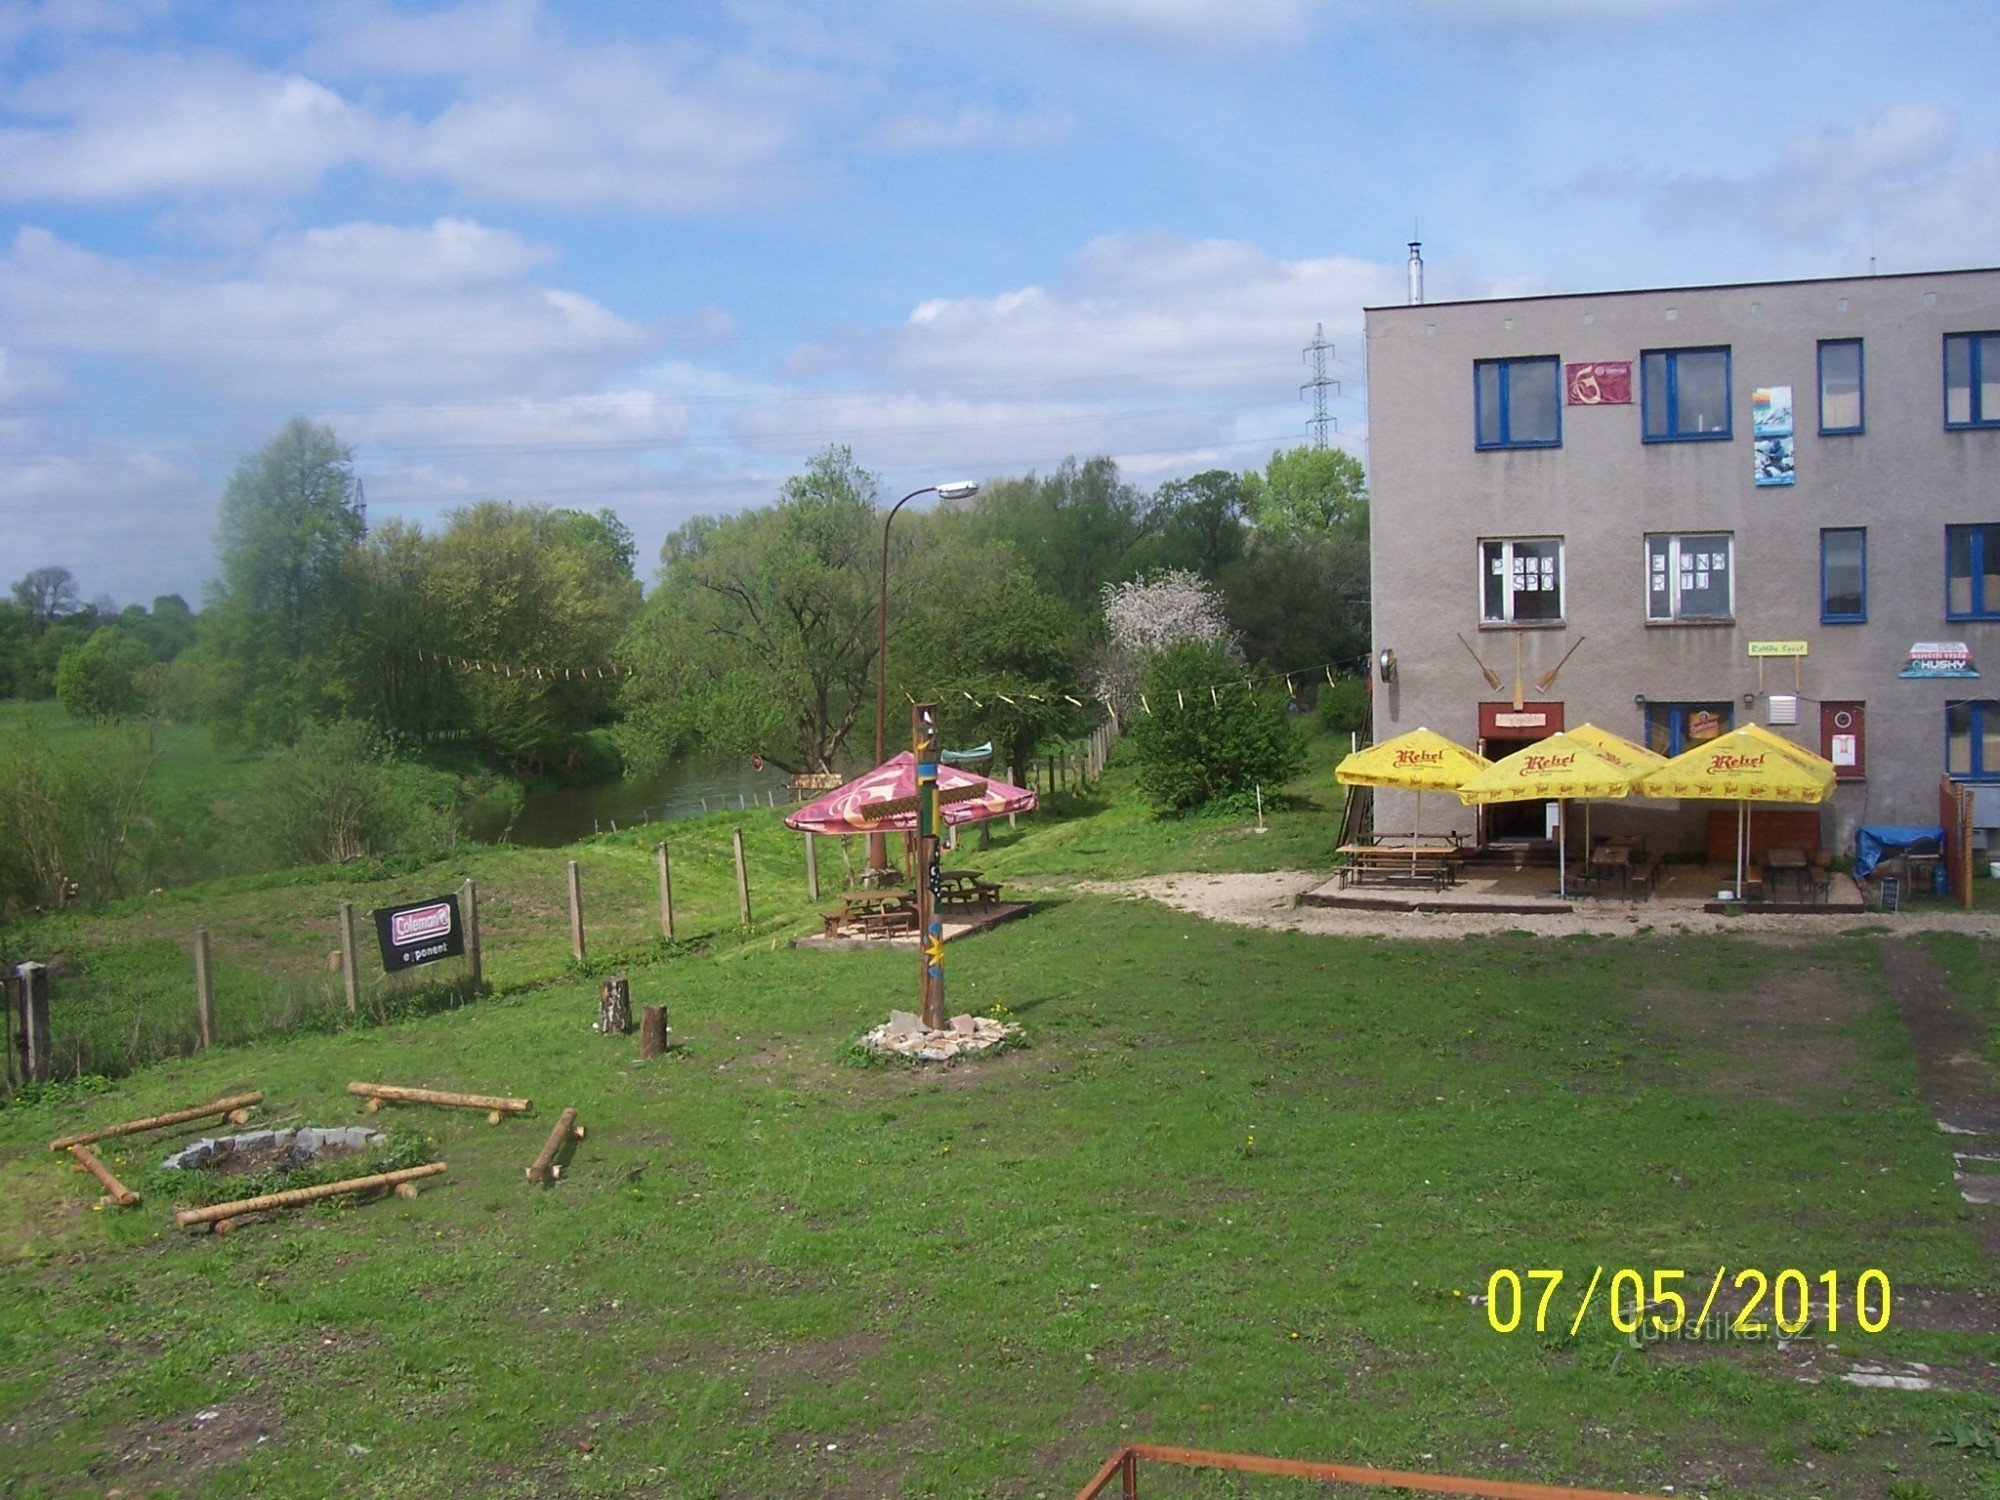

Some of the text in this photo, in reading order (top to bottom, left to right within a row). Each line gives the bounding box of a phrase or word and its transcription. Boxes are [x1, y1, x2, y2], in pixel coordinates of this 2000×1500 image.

[1921, 660, 1966, 669] HUSKY
[1394, 750, 1444, 766] Rebel
[1521, 753, 1575, 772] Rebel
[1708, 753, 1765, 771] Rebel
[396, 914, 438, 935] Coleman
[403, 942, 448, 961] eponent
